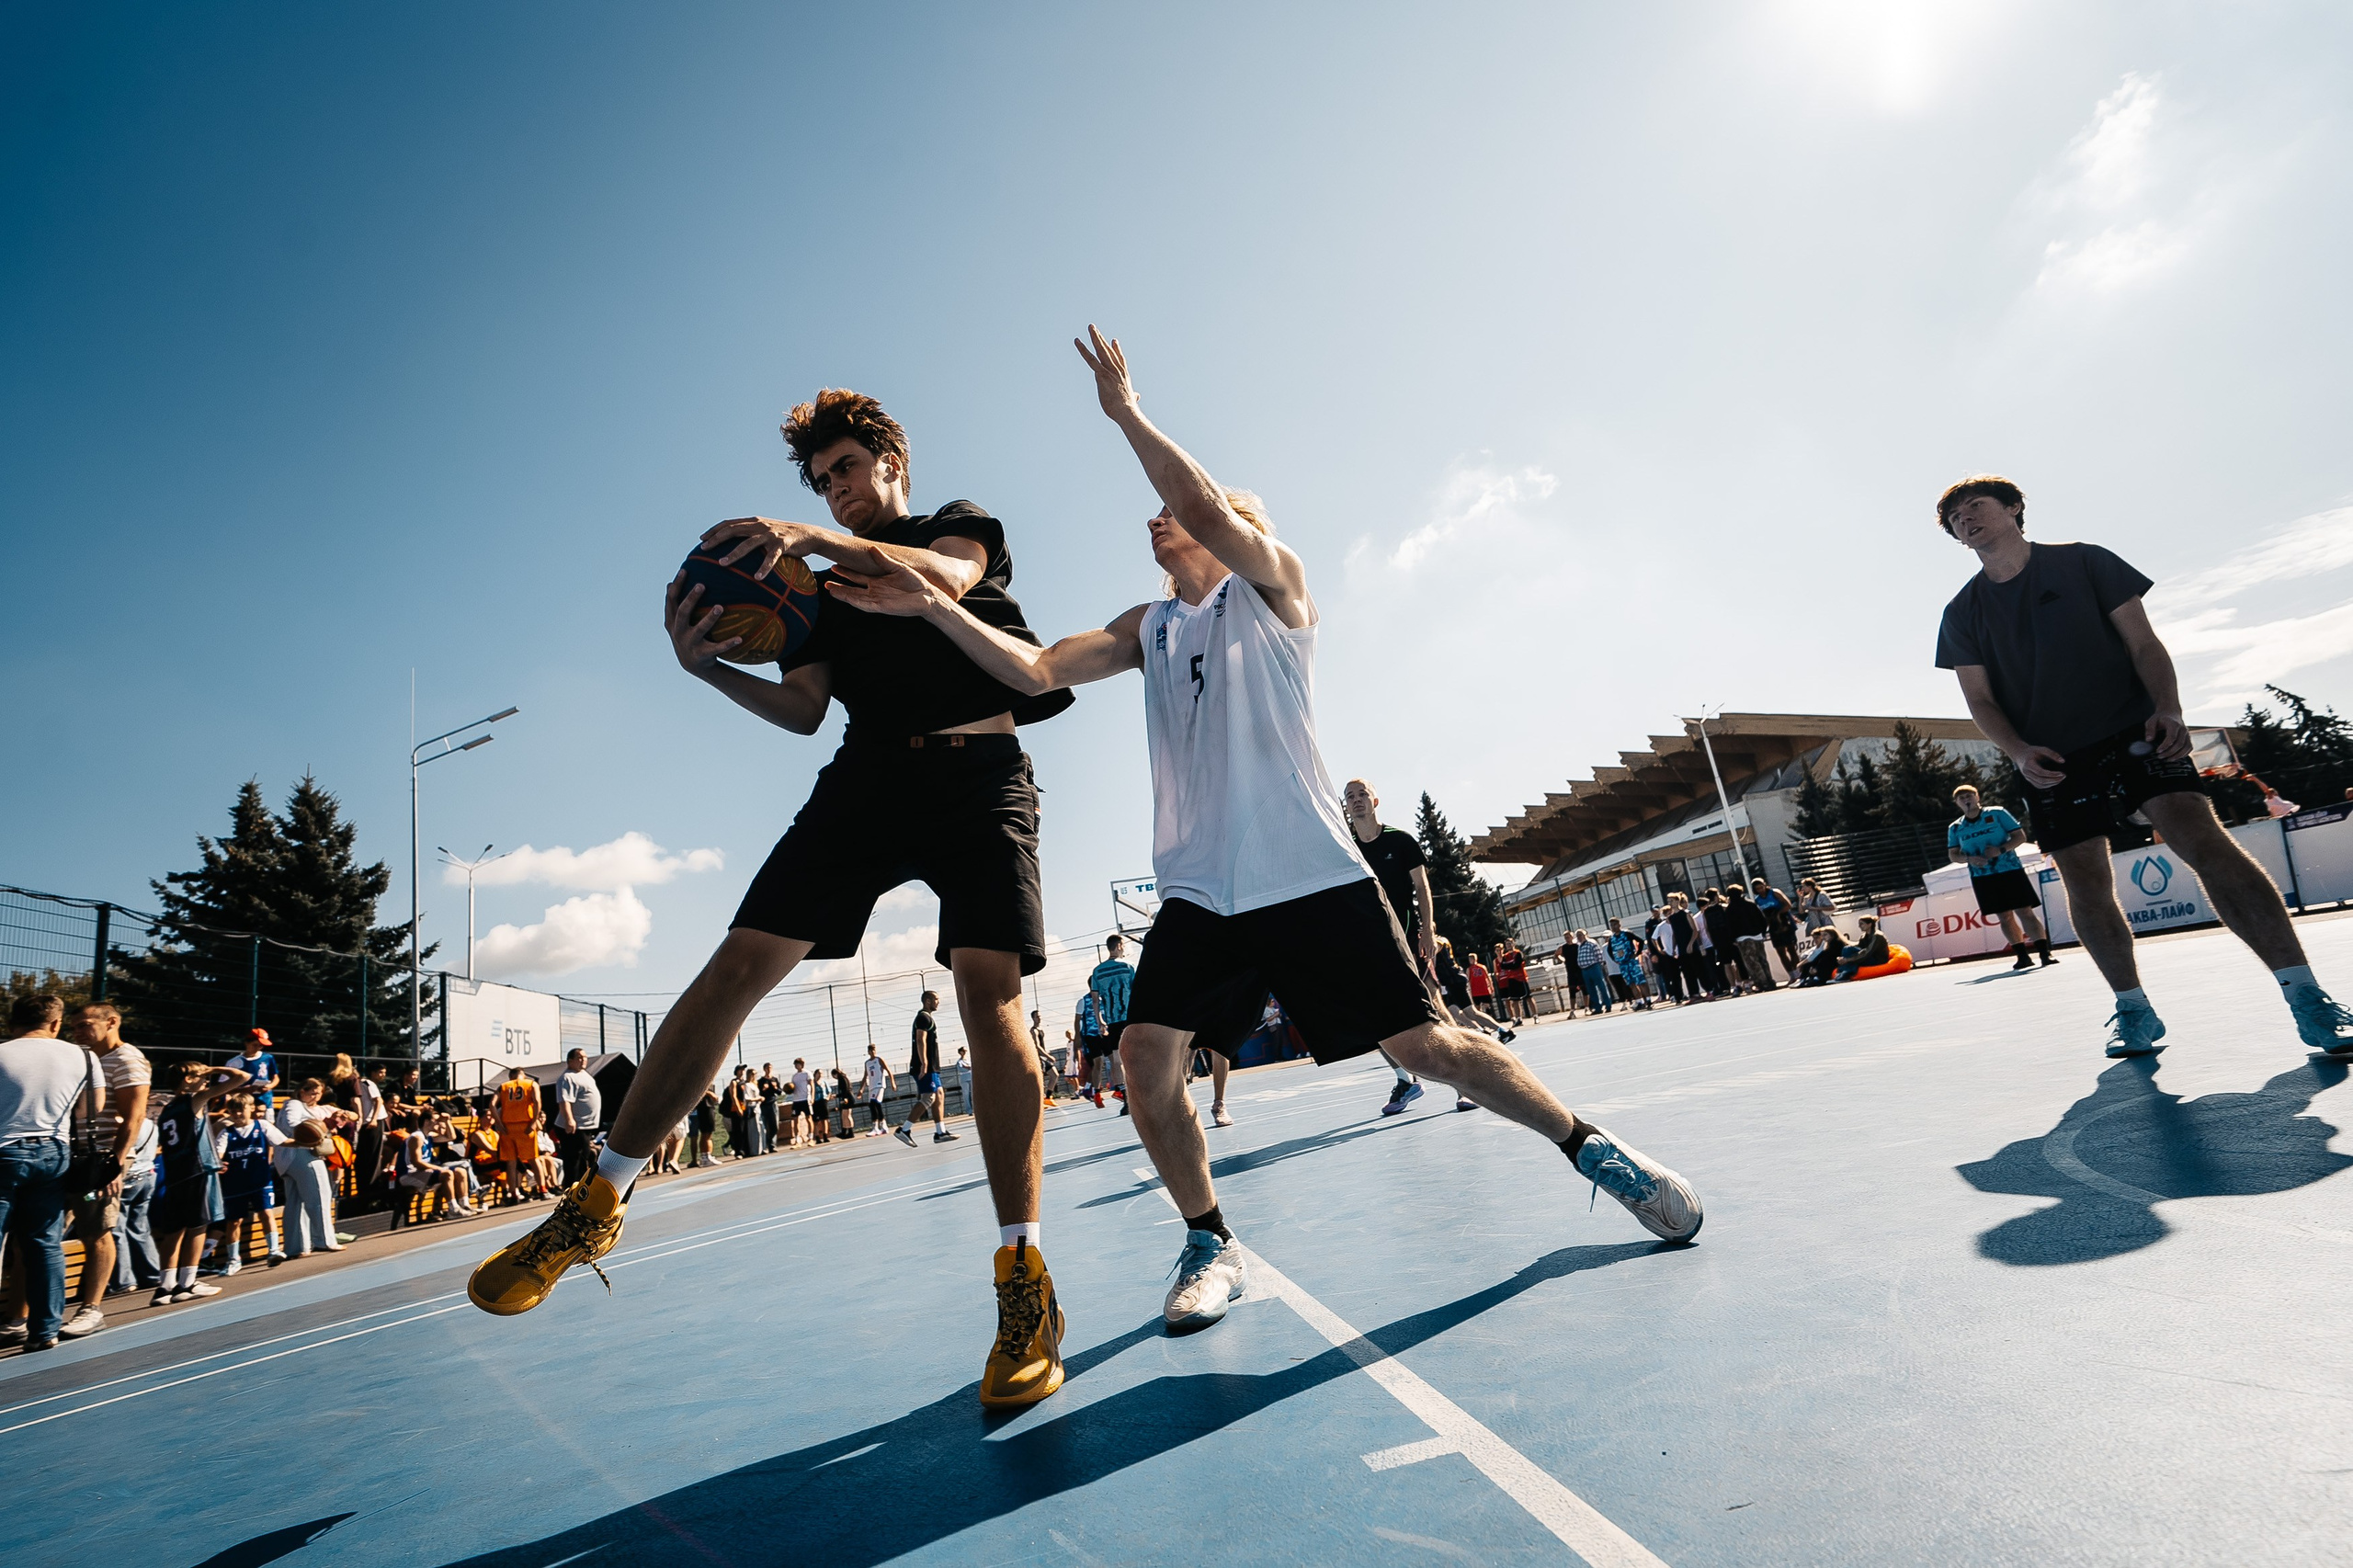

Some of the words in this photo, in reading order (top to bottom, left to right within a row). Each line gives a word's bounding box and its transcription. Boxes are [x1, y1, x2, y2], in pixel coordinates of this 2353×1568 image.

[506, 1028, 531, 1055] ВТБ
[508, 1086, 524, 1101] 13
[163, 1119, 179, 1145] 3
[241, 1158, 248, 1169] 7
